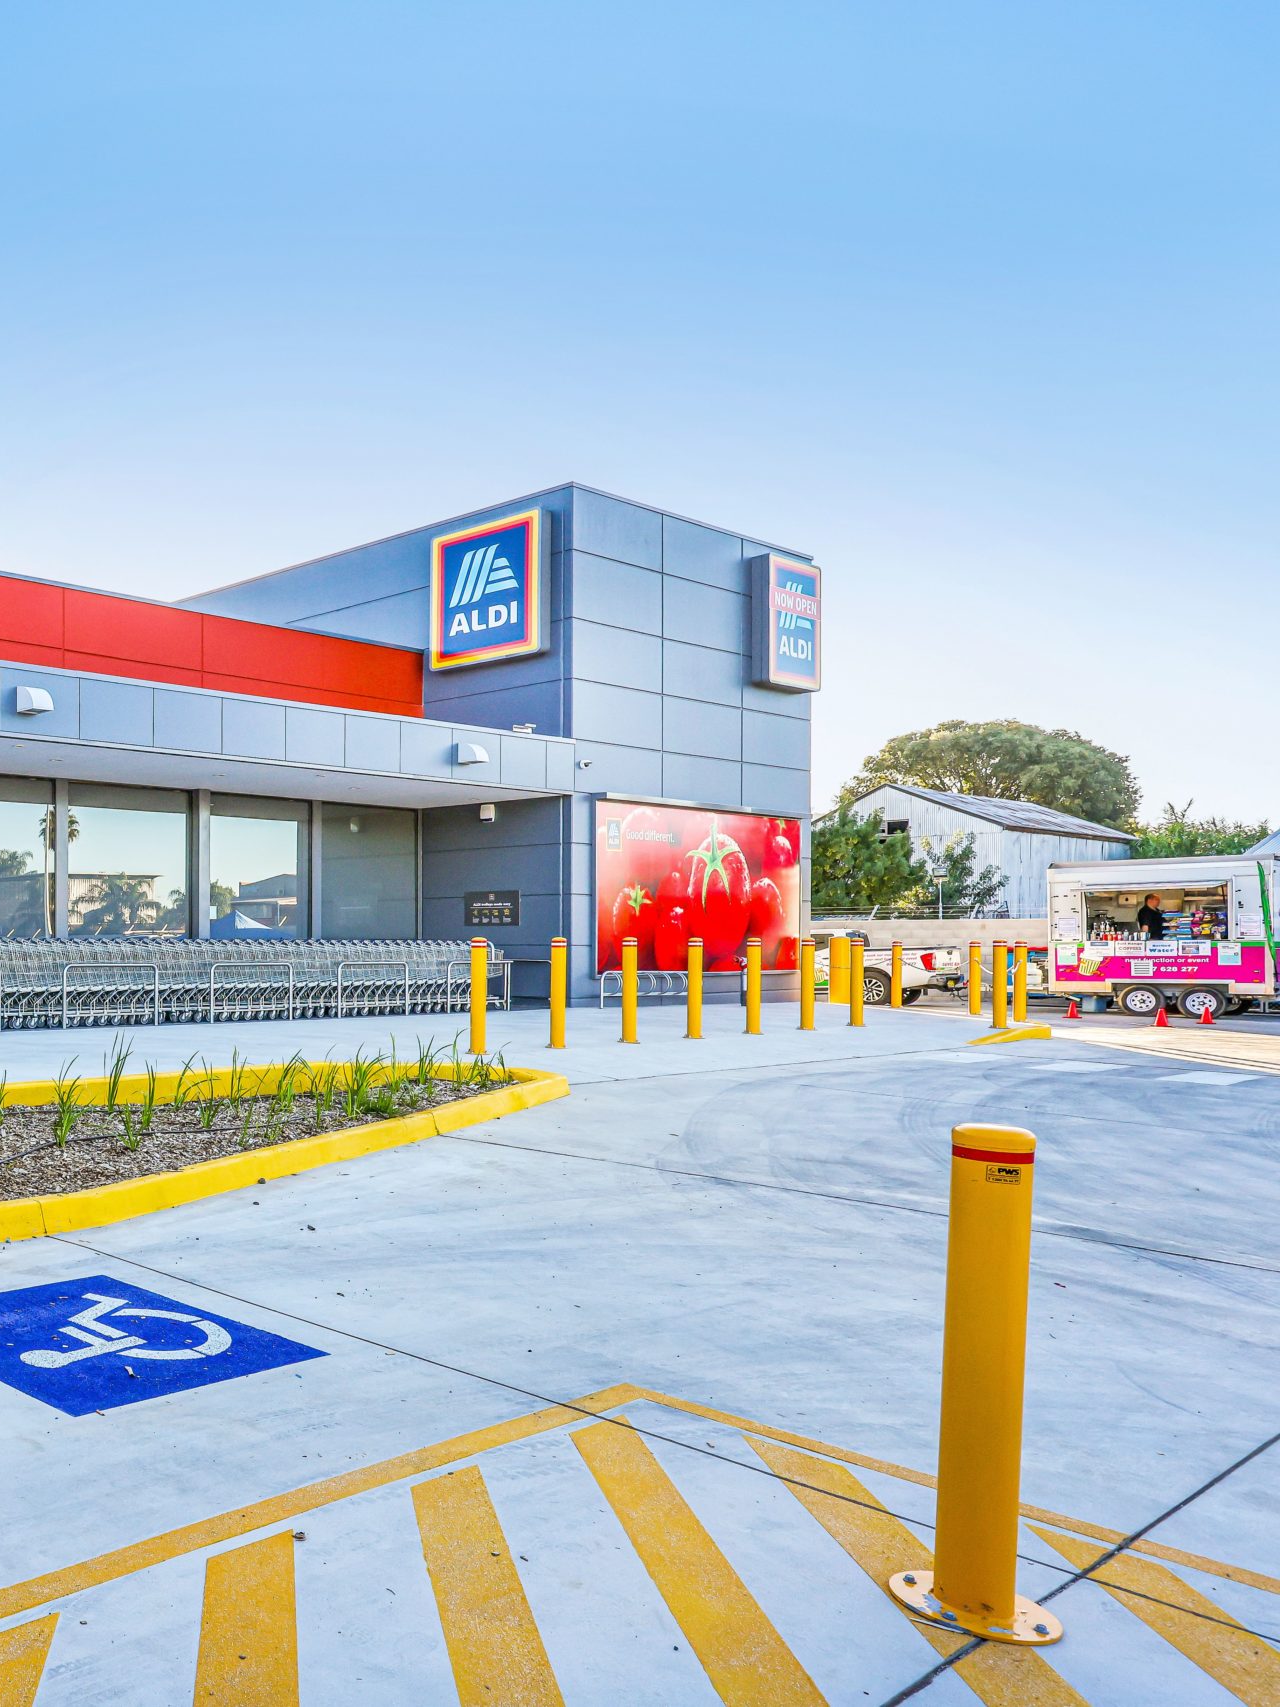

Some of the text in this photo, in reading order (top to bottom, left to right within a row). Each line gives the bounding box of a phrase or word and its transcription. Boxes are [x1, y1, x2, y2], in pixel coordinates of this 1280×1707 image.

[774, 591, 817, 616] NOW OPEN
[449, 600, 518, 637] ALDI
[779, 634, 812, 661] ALDI
[626, 829, 675, 843] Good different.
[997, 1167, 1020, 1176] PWS
